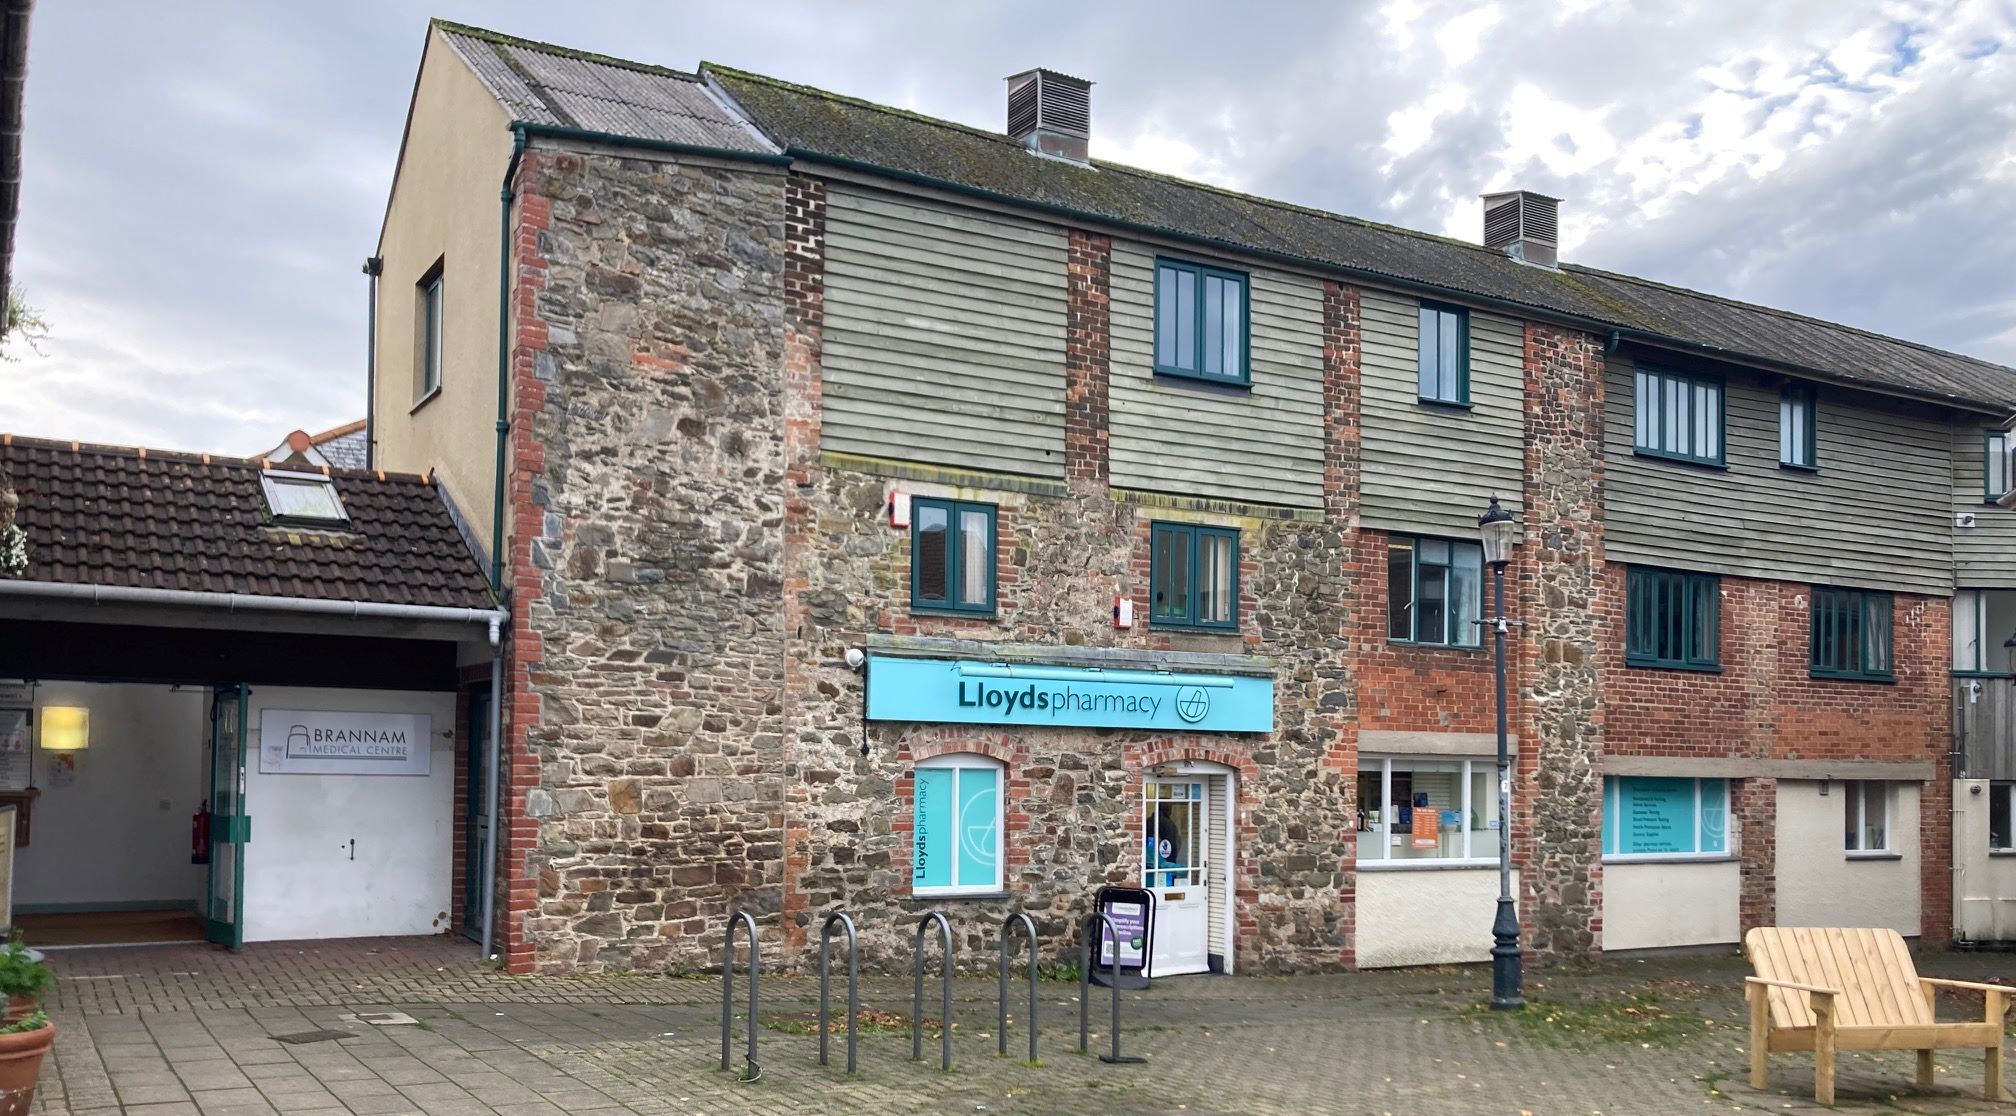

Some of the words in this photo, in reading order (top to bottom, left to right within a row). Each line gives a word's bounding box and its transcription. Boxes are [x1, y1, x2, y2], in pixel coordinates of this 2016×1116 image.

[314, 728, 406, 744] BRANNAM
[312, 745, 361, 755] MEDICAL
[366, 745, 408, 756] CENTRE
